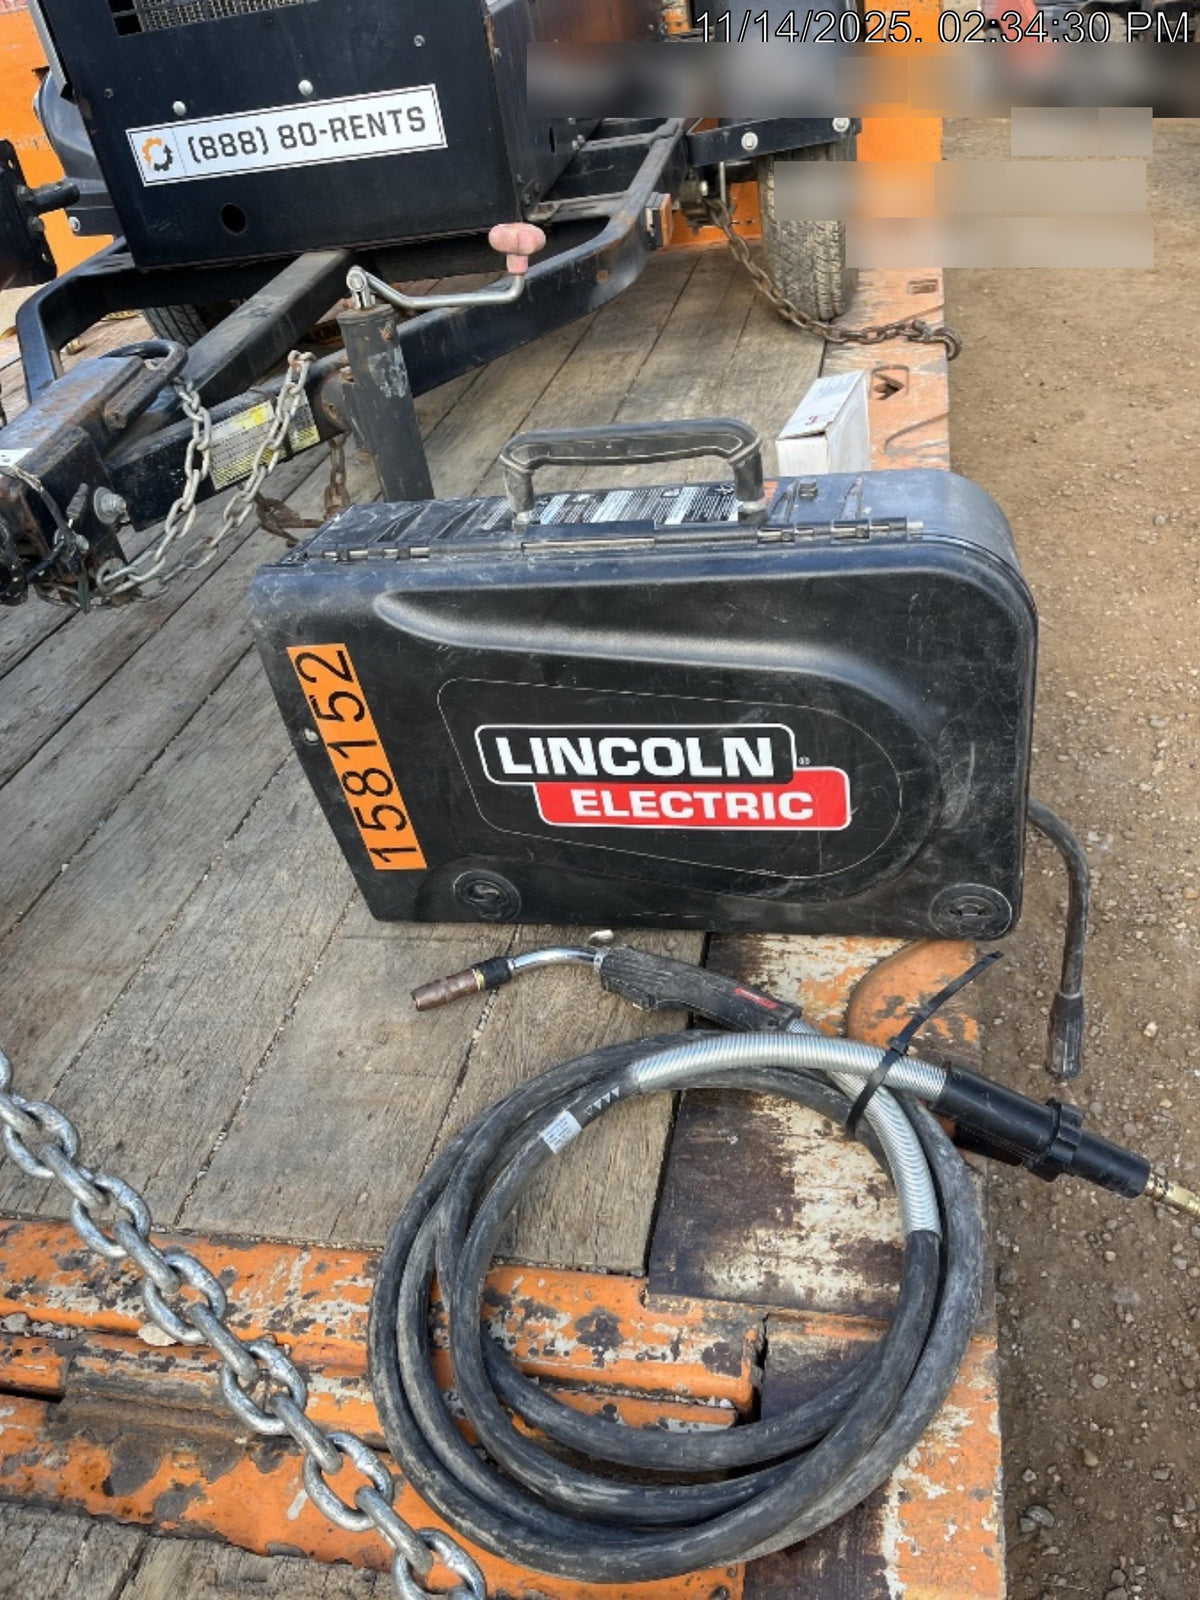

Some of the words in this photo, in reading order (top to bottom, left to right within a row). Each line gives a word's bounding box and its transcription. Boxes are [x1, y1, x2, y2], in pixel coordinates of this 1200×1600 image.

[187, 126, 269, 165] (888)
[277, 105, 427, 150] 80-RENTS
[295, 649, 417, 863] 158152
[495, 736, 775, 778] LINCOLN
[570, 788, 814, 820] ELECTRIC
